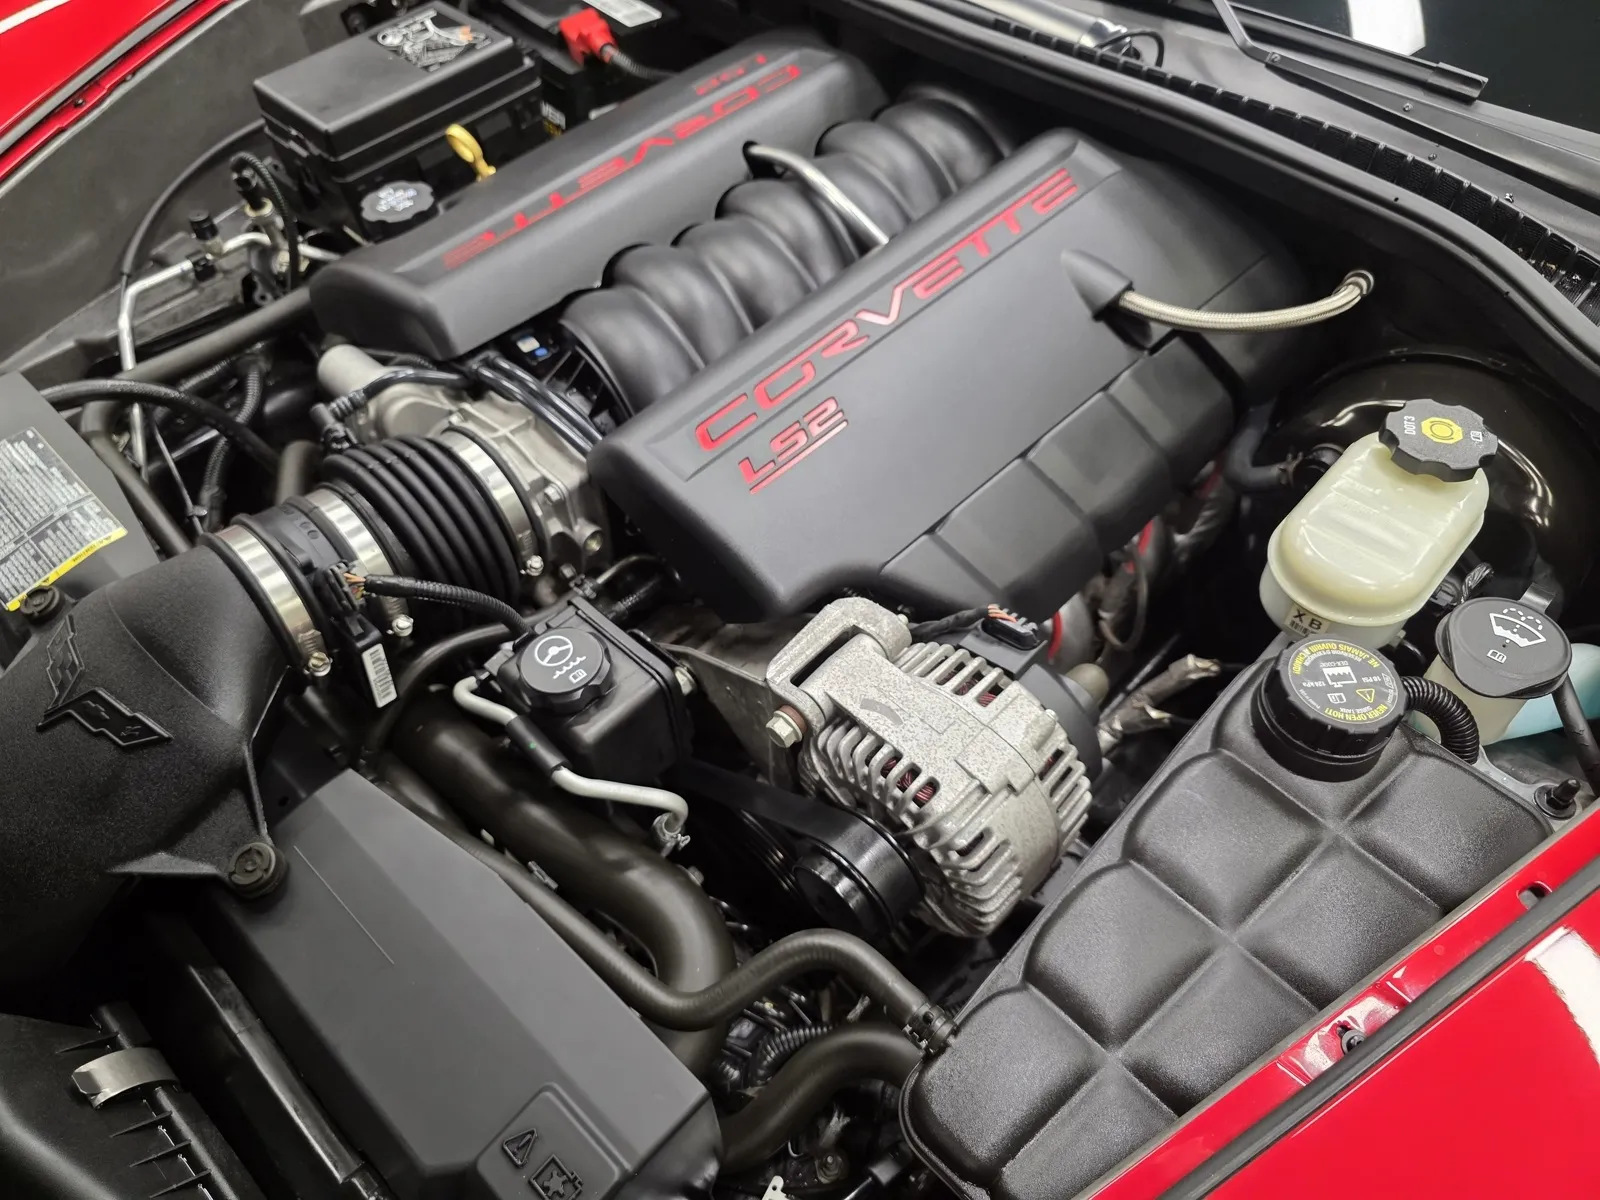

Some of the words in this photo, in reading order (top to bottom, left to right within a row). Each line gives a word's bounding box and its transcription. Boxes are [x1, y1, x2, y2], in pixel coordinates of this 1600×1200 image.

[444, 64, 801, 270] CORVETTE
[695, 168, 1078, 451] CORVETTE
[738, 396, 845, 487] LS2
[1338, 643, 1370, 660] JAMAIS
[1324, 707, 1344, 720] HOT!
[1345, 712, 1367, 721] OPEN
[1366, 703, 1388, 719] NEVER
